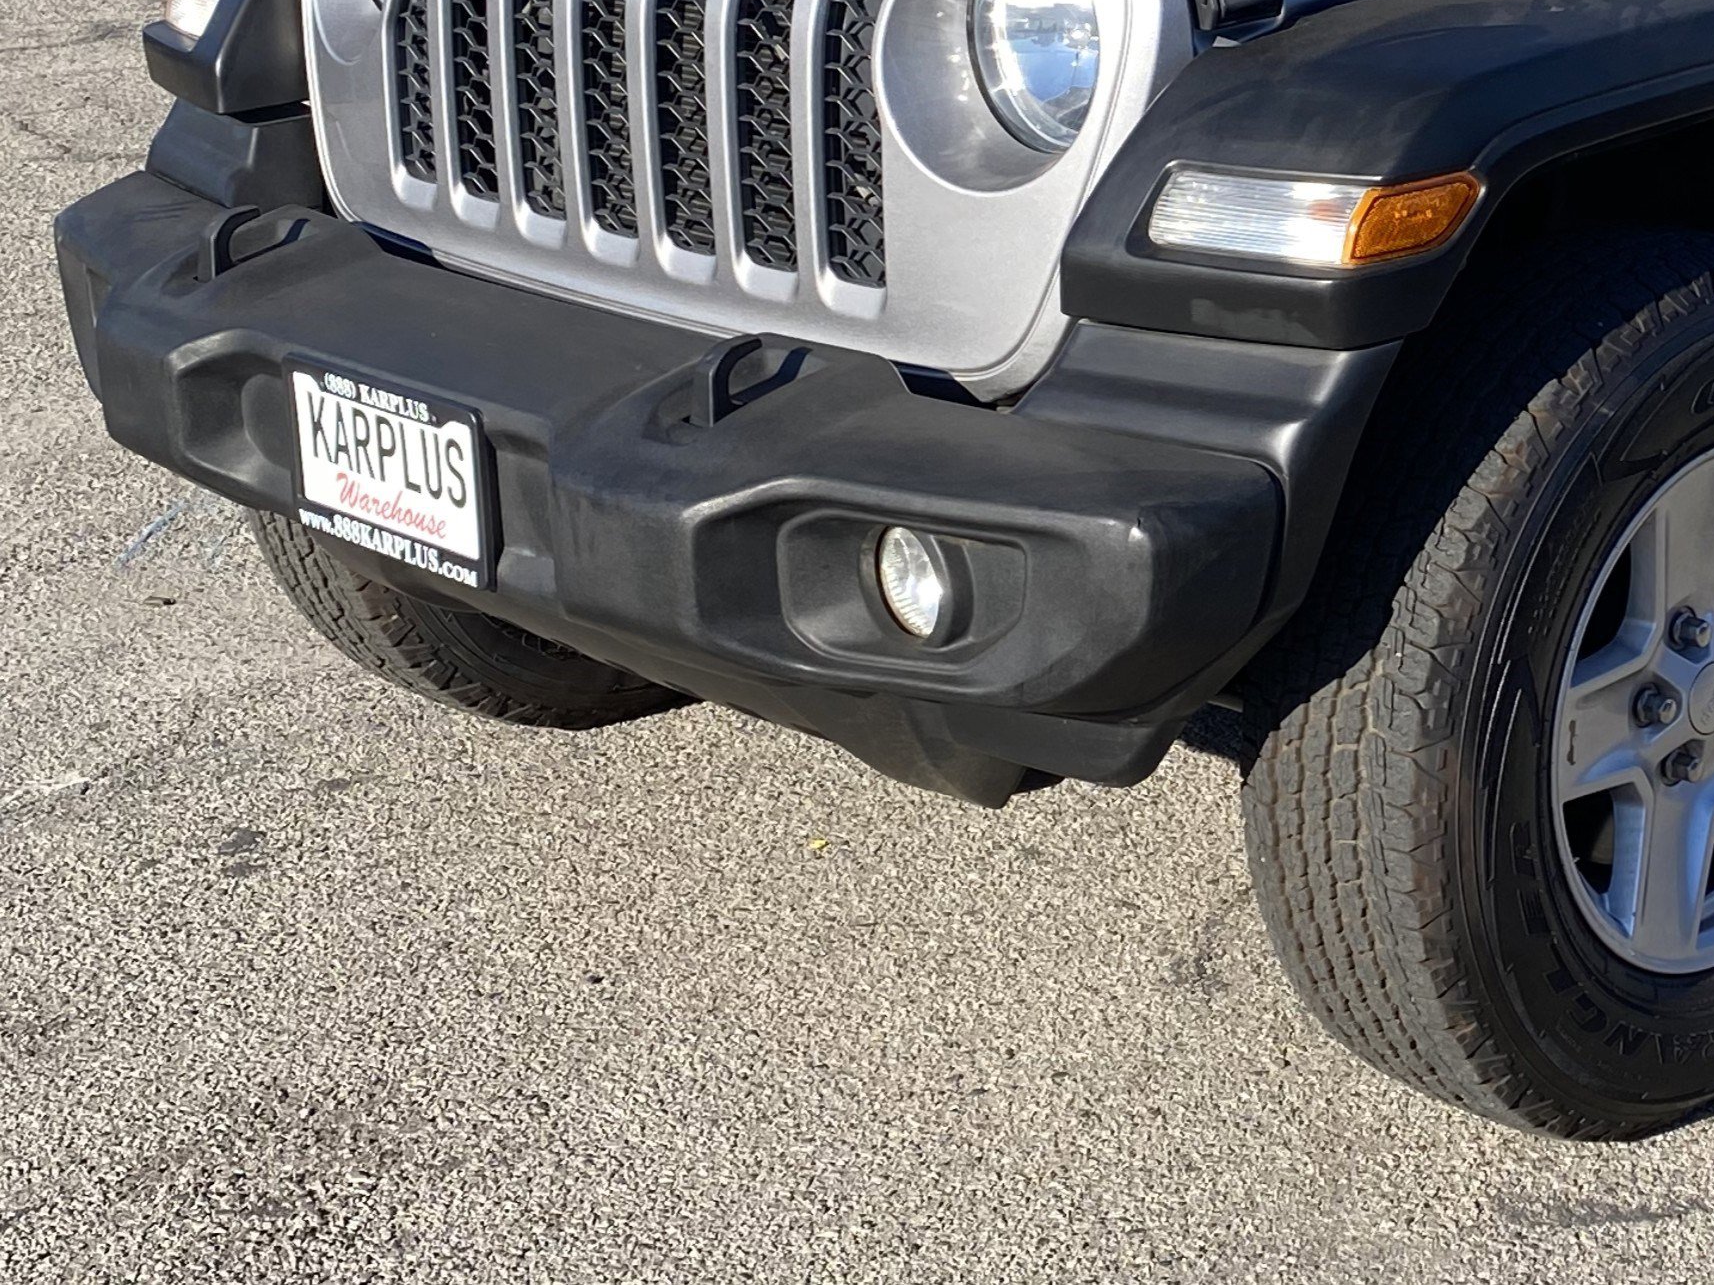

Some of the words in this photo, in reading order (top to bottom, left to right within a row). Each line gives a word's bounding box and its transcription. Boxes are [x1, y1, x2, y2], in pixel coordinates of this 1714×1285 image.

[323, 372, 357, 399] (888)
[358, 383, 430, 422] KARPLUS
[307, 390, 467, 510] KARPLUS
[336, 472, 447, 540] Warehouse
